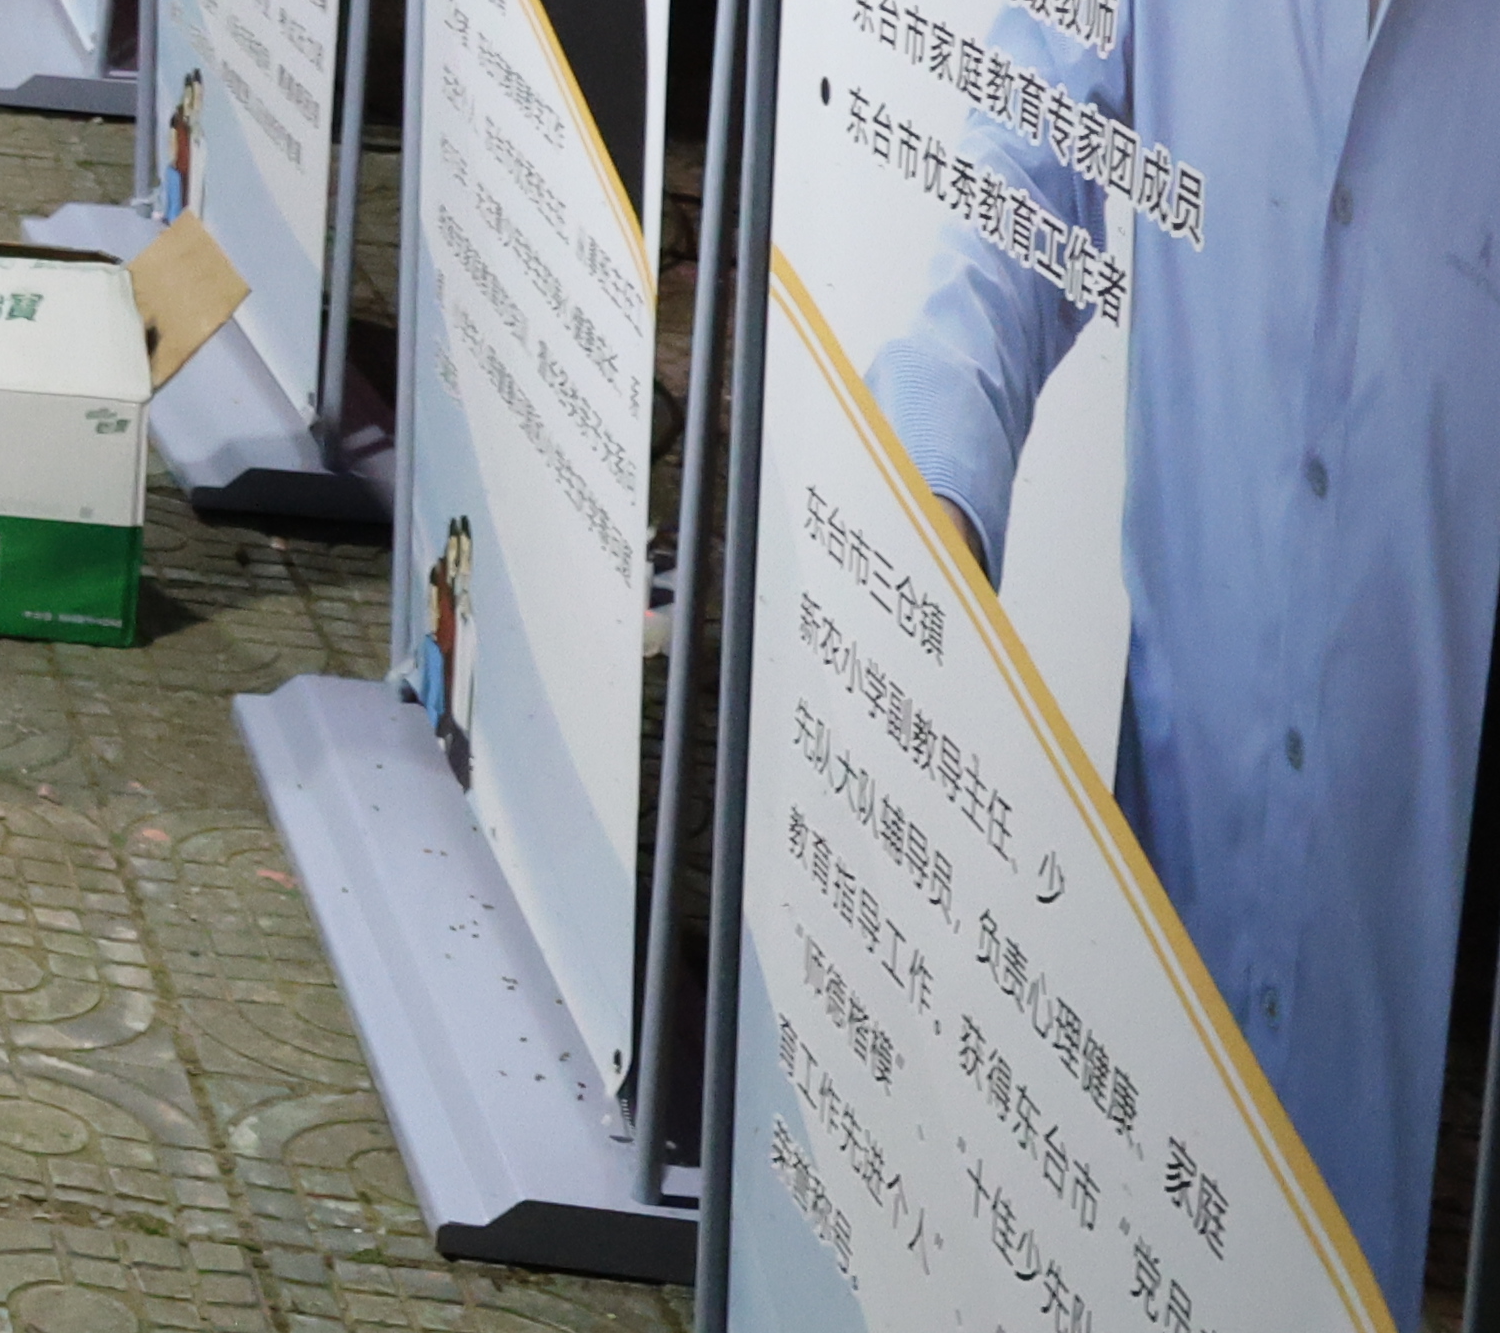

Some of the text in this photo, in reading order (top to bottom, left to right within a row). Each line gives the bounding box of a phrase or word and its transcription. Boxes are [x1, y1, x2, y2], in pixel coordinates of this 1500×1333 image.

[845, 85, 1129, 329] 东台市优秀教育工作者
[802, 484, 948, 668] 东台市三仓镇
